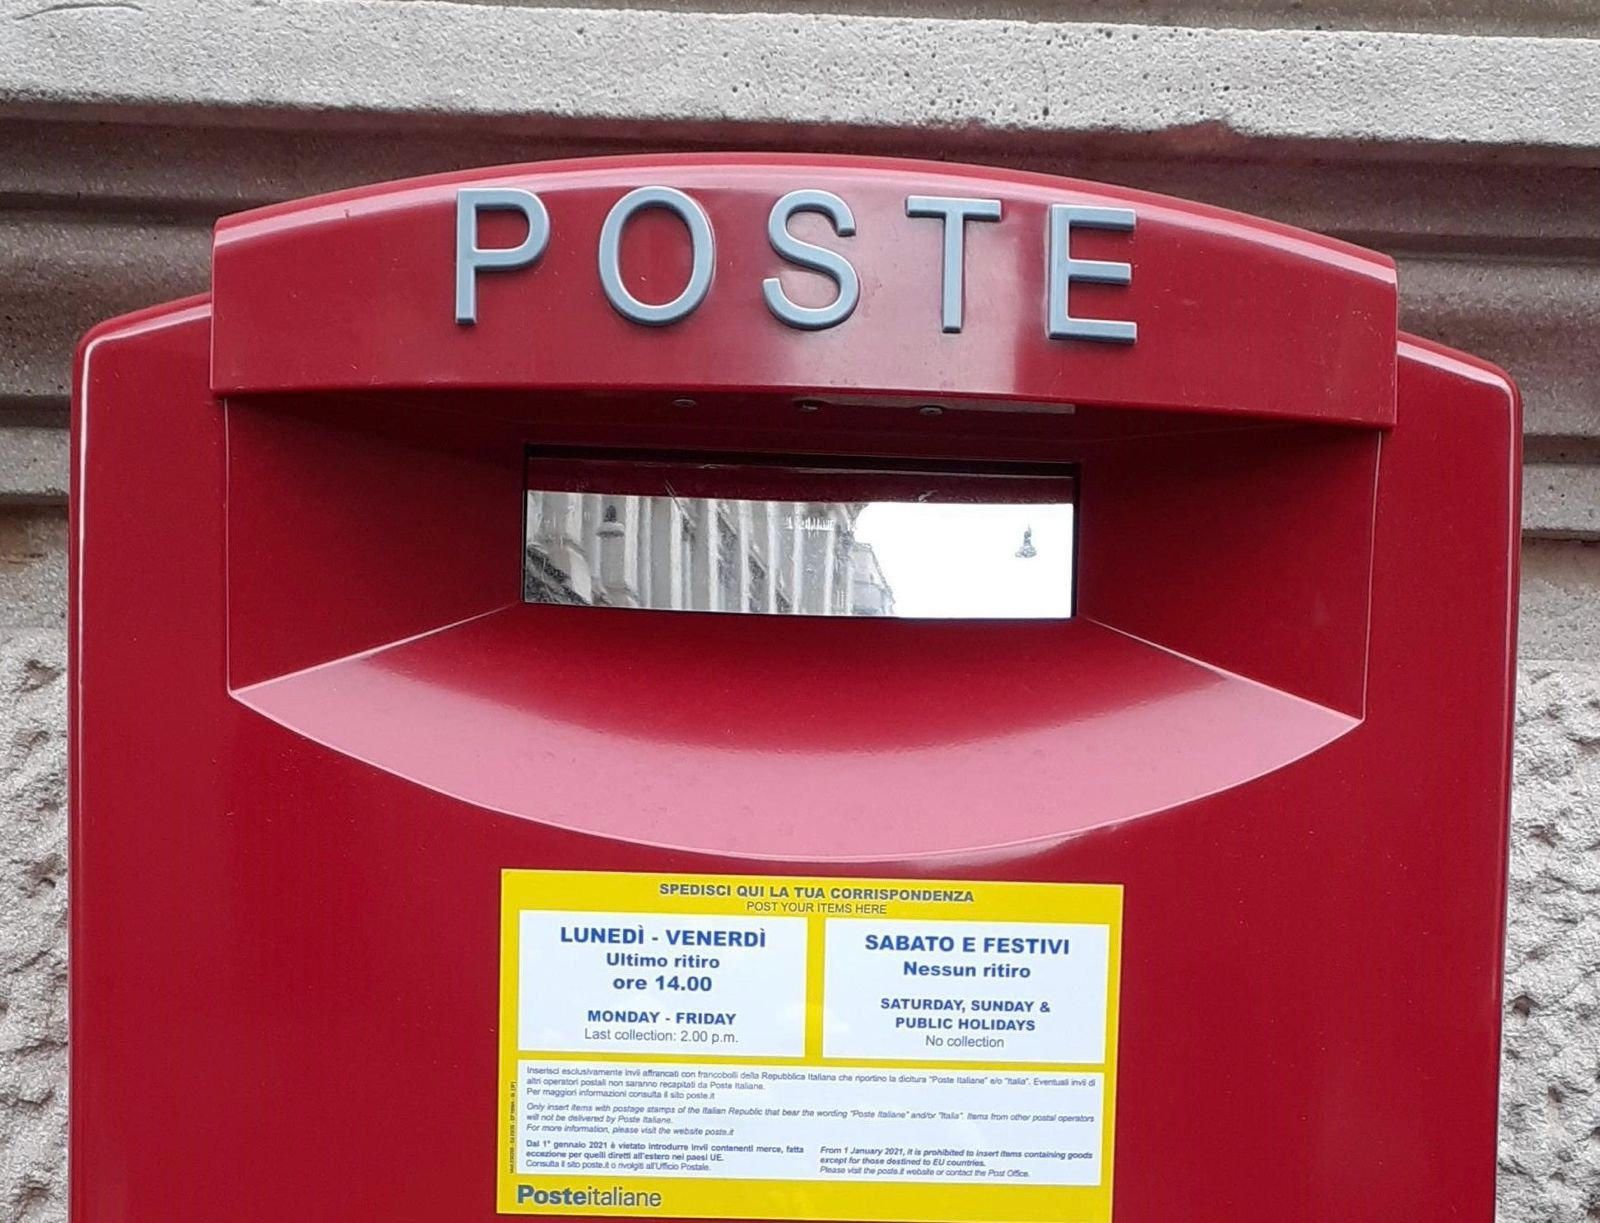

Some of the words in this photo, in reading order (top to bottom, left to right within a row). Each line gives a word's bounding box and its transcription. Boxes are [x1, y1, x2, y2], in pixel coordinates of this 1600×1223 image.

[454, 186, 1138, 343] POSTE
[659, 883, 731, 896] SPEDISCI
[736, 885, 764, 897] QUI
[769, 886, 789, 898] LA
[793, 886, 825, 898] TUA
[830, 887, 974, 902] CORRISPONDENZA
[746, 900, 778, 912] POST
[780, 901, 814, 913] YOUR
[817, 902, 852, 913] ITEMS
[855, 903, 887, 914] HERE
[560, 922, 644, 944] LUNEDÌ
[665, 925, 765, 947] VENERDÌ
[865, 934, 954, 952] SABATO
[962, 936, 975, 952] E
[983, 936, 1069, 955] FESTIVI
[606, 952, 668, 967] Ultimo
[674, 953, 720, 968] ritiro
[903, 960, 976, 977] Nessun
[983, 962, 1030, 978] ritiro
[612, 977, 647, 990] ore
[655, 975, 712, 991] 14.00
[880, 997, 965, 1012] SATURDAY,
[970, 999, 1034, 1012] SUNDAY
[1039, 1001, 1050, 1013] &
[587, 1009, 660, 1023] MONDAY
[675, 1011, 736, 1025] FRIDAY
[895, 1016, 953, 1029] PUBLIC
[958, 1018, 1035, 1031] HOLIDAYS
[584, 1027, 611, 1040] Last
[614, 1028, 676, 1041] collection:
[680, 1029, 708, 1042] 2.00
[711, 1032, 738, 1045] p.m.
[925, 1034, 944, 1046] No
[946, 1034, 1004, 1048] collection
[526, 1065, 559, 1075] Inserisci
[561, 1067, 623, 1076] esclusivamente
[641, 1068, 679, 1078] affrancati
[697, 1069, 738, 1079] francobolli
[739, 1071, 759, 1079] della
[761, 1071, 806, 1081] Repubblica
[807, 1072, 836, 1081] Italiana
[838, 1073, 853, 1081] che
[888, 1074, 896, 1082] la
[897, 1074, 927, 1083] dicitura
[1033, 1076, 1069, 1086] Eventuali
[1087, 1078, 1096, 1087] di
[526, 1076, 542, 1085] altri
[542, 1077, 579, 1087] operatori
[580, 1077, 606, 1088] postali
[607, 1079, 623, 1087] non
[625, 1080, 658, 1088] saranno
[658, 1080, 696, 1090] recapitati
[697, 1080, 708, 1089] da
[709, 1080, 732, 1089] Poste
[526, 1087, 541, 1095] Per
[542, 1087, 577, 1098] maggiori
[578, 1088, 627, 1098] informazioni
[627, 1089, 662, 1098] consulta
[663, 1090, 668, 1098] il
[669, 1090, 684, 1099] sito
[685, 1091, 715, 1101] poste.it
[525, 1101, 546, 1112] Only
[546, 1102, 569, 1111] insert
[570, 1103, 593, 1112] items
[593, 1103, 611, 1112] with
[611, 1104, 645, 1114] postage
[645, 1105, 676, 1115] stamps
[676, 1105, 686, 1113] of
[686, 1105, 700, 1114] the
[701, 1106, 726, 1115] Italian
[727, 1106, 763, 1116] Republic
[763, 1107, 780, 1116] that
[781, 1108, 800, 1116] bear
[801, 1108, 815, 1117] the
[815, 1108, 848, 1119] wording
[966, 1112, 989, 1120] Items
[989, 1112, 1009, 1121] from
[1009, 1113, 1031, 1121] other
[1031, 1113, 1057, 1123] postal
[1057, 1113, 1095, 1123] operators
[525, 1112, 539, 1121] will
[539, 1113, 554, 1121] not
[554, 1113, 566, 1121] be
[566, 1113, 604, 1122] delivered
[604, 1114, 616, 1124] by
[616, 1114, 641, 1124] Poste
[525, 1122, 540, 1131] For
[541, 1124, 563, 1132] more
[611, 1125, 639, 1135] please
[640, 1125, 657, 1134] visit
[657, 1126, 671, 1134] the
[672, 1126, 703, 1135] website
[704, 1127, 734, 1137] poste.it
[525, 1139, 540, 1147] Dal
[553, 1140, 586, 1150] gennaio
[588, 1140, 607, 1149] 2021
[617, 1141, 646, 1150] vietato
[647, 1142, 688, 1151] introdurre
[710, 1143, 753, 1152] contenenti
[755, 1145, 783, 1154] merce,
[785, 1144, 804, 1153] fatta
[819, 1145, 842, 1154] From
[843, 1146, 848, 1154] 1
[849, 1146, 883, 1156] January
[906, 1147, 913, 1155] it
[913, 1147, 922, 1156] is
[922, 1147, 965, 1158] prohibited
[965, 1149, 975, 1157] to
[975, 1149, 999, 1157] insert
[999, 1150, 1022, 1158] items
[1023, 1150, 1066, 1160] containing
[1066, 1151, 1093, 1161] goods
[525, 1149, 567, 1158] eccezione
[568, 1151, 582, 1160] per
[583, 1150, 606, 1160] quelli
[607, 1151, 631, 1159] diretti
[671, 1152, 684, 1160] nei
[685, 1152, 708, 1162] paesi
[709, 1153, 724, 1161] UE.
[819, 1156, 847, 1165] except
[847, 1155, 861, 1164] for
[861, 1156, 885, 1165] those
[885, 1157, 921, 1165] destined
[921, 1158, 931, 1166] to
[931, 1158, 945, 1166] EU
[945, 1158, 986, 1167] countries.
[517, 1184, 661, 1207] Posteitaliane
